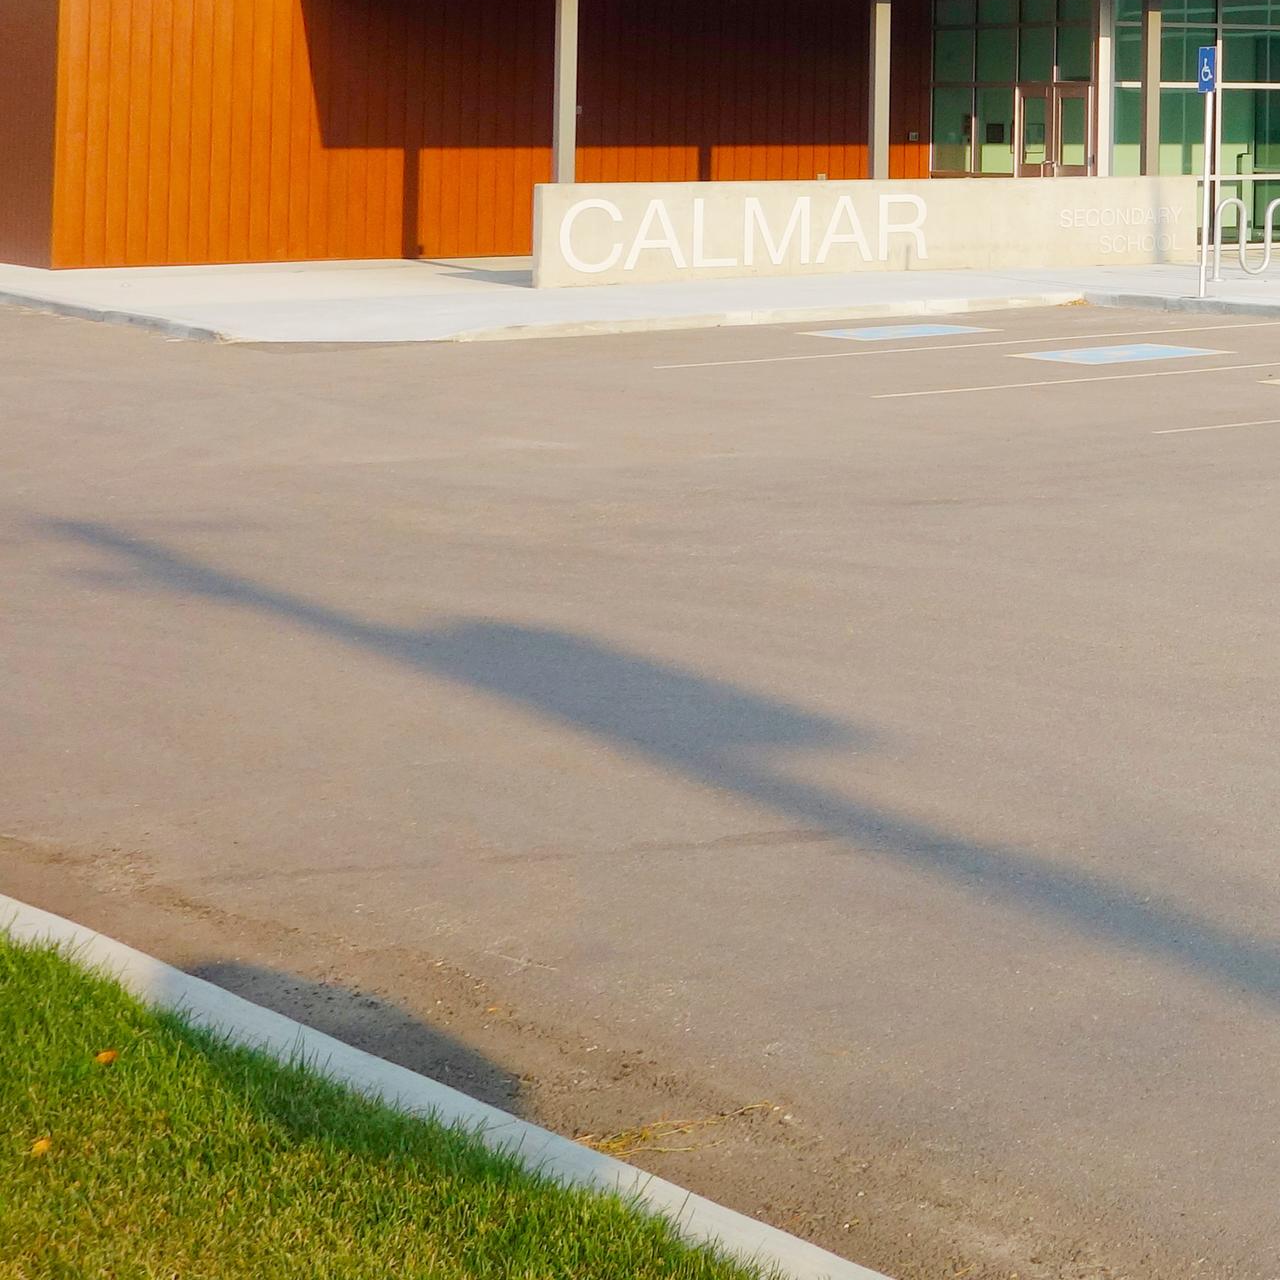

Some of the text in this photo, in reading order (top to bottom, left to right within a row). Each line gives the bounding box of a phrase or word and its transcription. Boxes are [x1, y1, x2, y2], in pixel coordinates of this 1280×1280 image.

[1060, 207, 1182, 228] SECONDARY
[559, 194, 929, 273] CALMAR
[1100, 234, 1182, 253] SCHOOL
